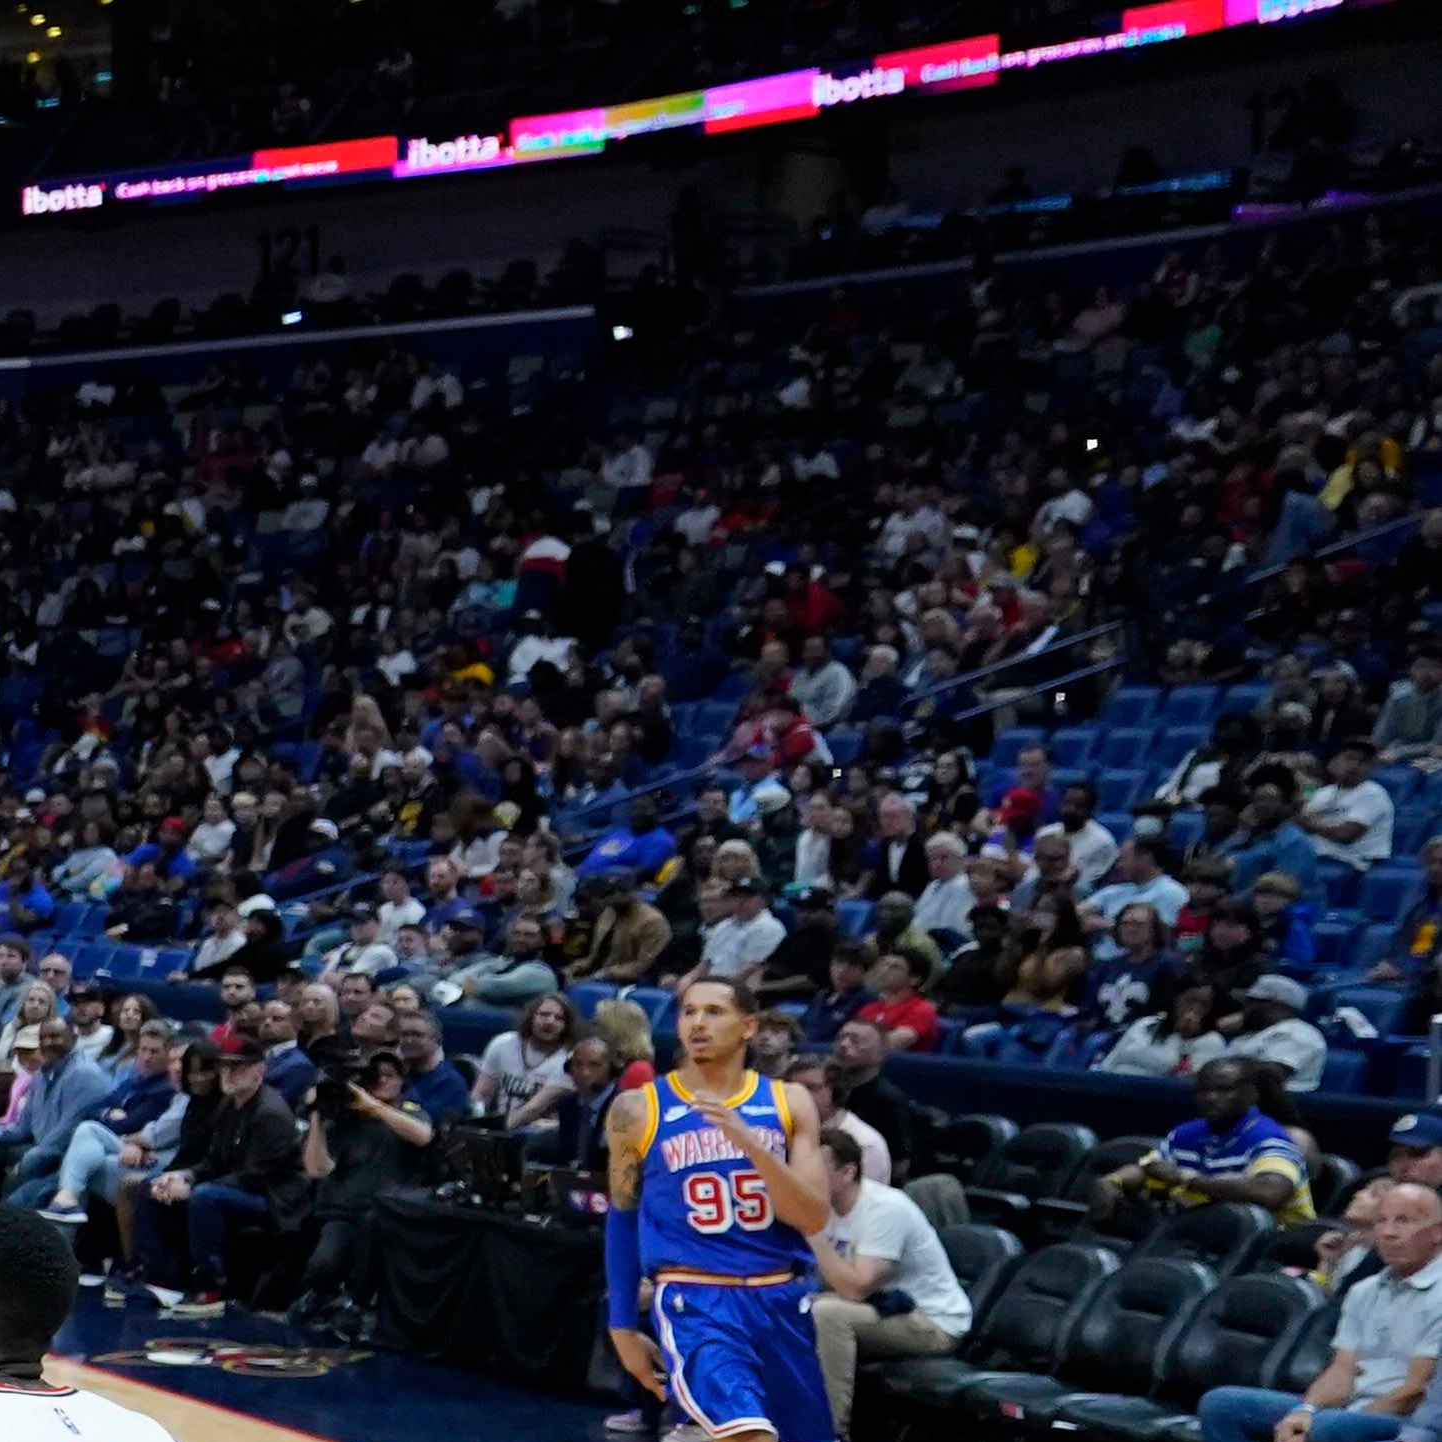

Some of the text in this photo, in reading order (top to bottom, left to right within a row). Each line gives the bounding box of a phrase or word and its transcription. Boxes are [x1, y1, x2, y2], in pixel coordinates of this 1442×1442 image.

[407, 136, 502, 169] ibotta
[21, 183, 103, 216] ibotta
[682, 1169, 774, 1235] 95
